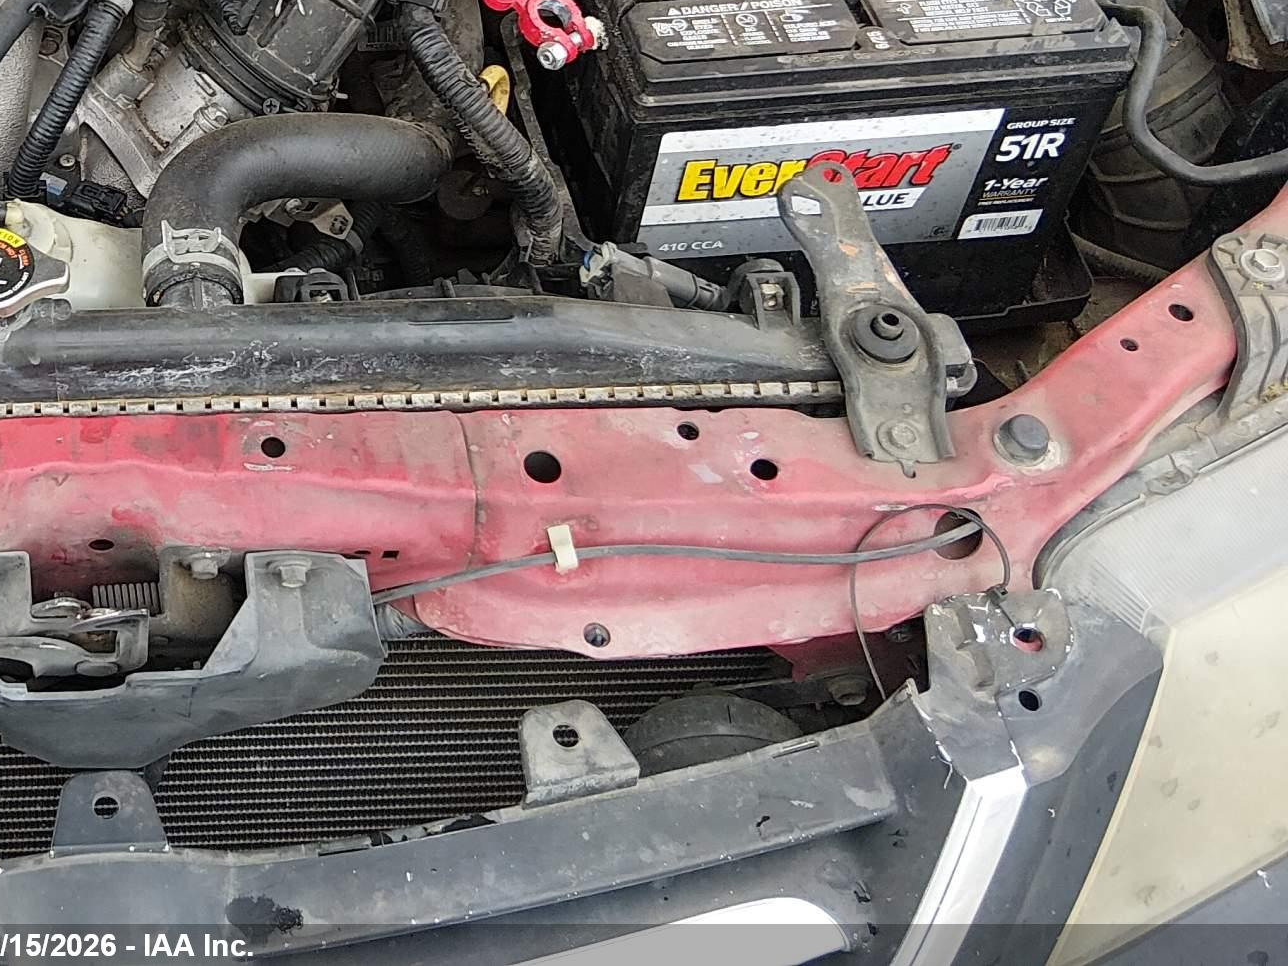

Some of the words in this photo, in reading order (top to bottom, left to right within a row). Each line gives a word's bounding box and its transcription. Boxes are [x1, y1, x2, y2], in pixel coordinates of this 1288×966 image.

[680, 0, 740, 15] DANGER
[1006, 119, 1049, 130] GROUP
[1049, 117, 1077, 126] SIZE
[995, 131, 1066, 163] 51R
[984, 176, 1049, 191] 1-Year
[862, 192, 910, 207] LUE
[982, 188, 1038, 199] WARRANTY
[658, 241, 689, 253] 410
[690, 239, 724, 251] CCA
